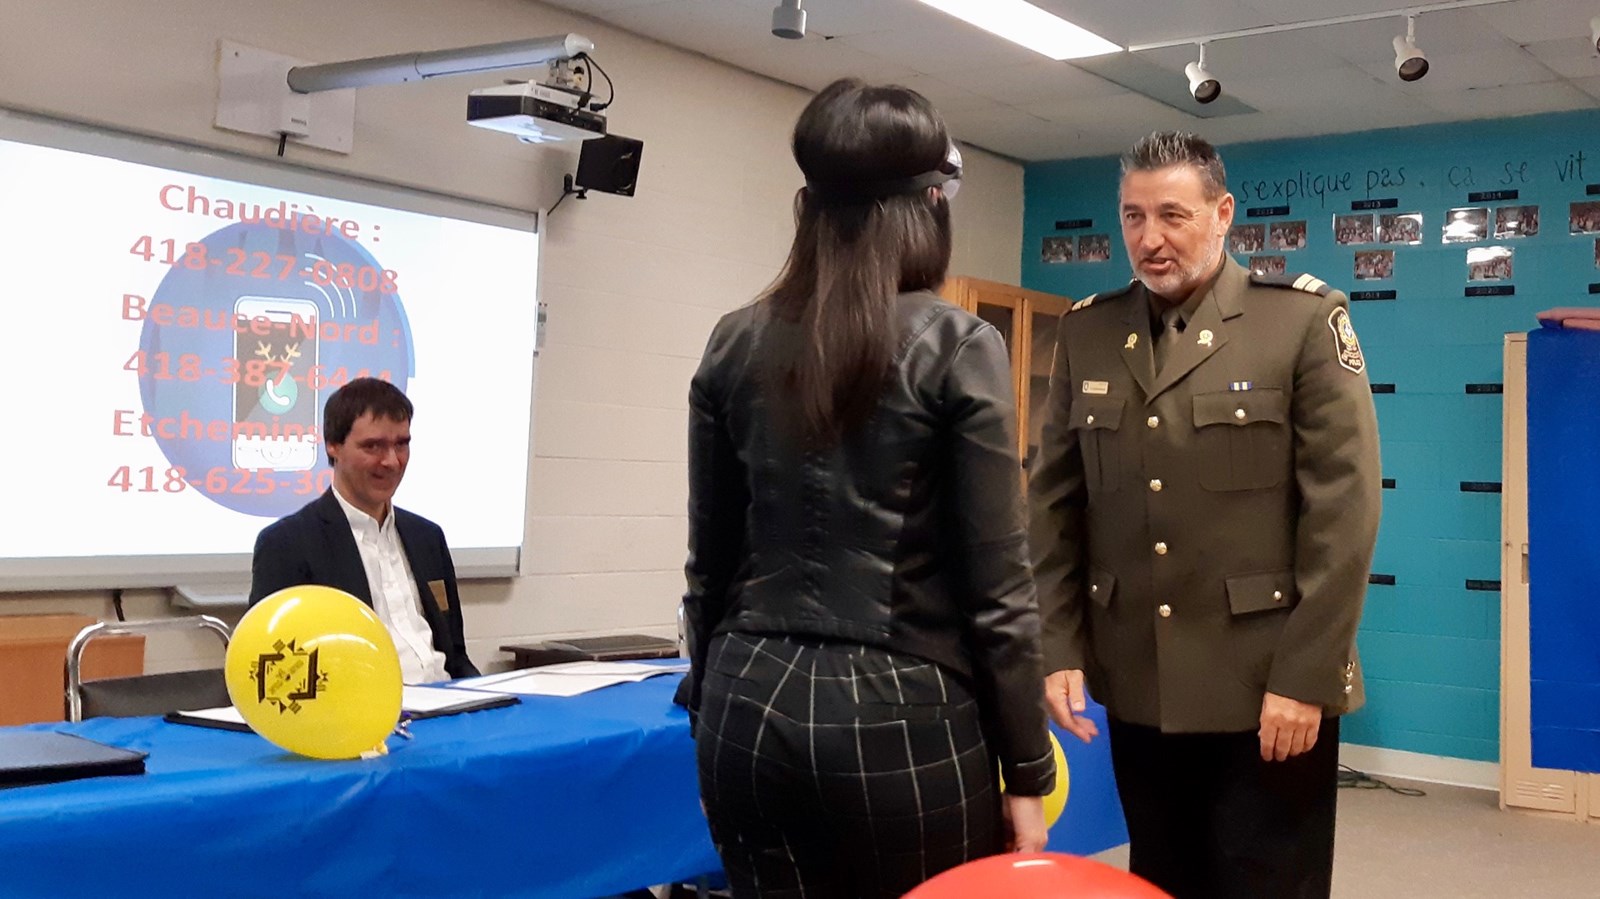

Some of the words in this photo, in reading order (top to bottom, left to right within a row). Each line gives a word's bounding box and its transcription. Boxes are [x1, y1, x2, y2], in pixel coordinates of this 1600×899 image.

[1500, 161, 1530, 185] se
[1554, 150, 1587, 182] vit
[159, 184, 360, 241] Chaudière
[129, 235, 398, 294] 418-227-0808
[122, 294, 379, 345] Beauce-Nord
[112, 409, 324, 444] Etchemins
[107, 465, 334, 496] 418-625-30
